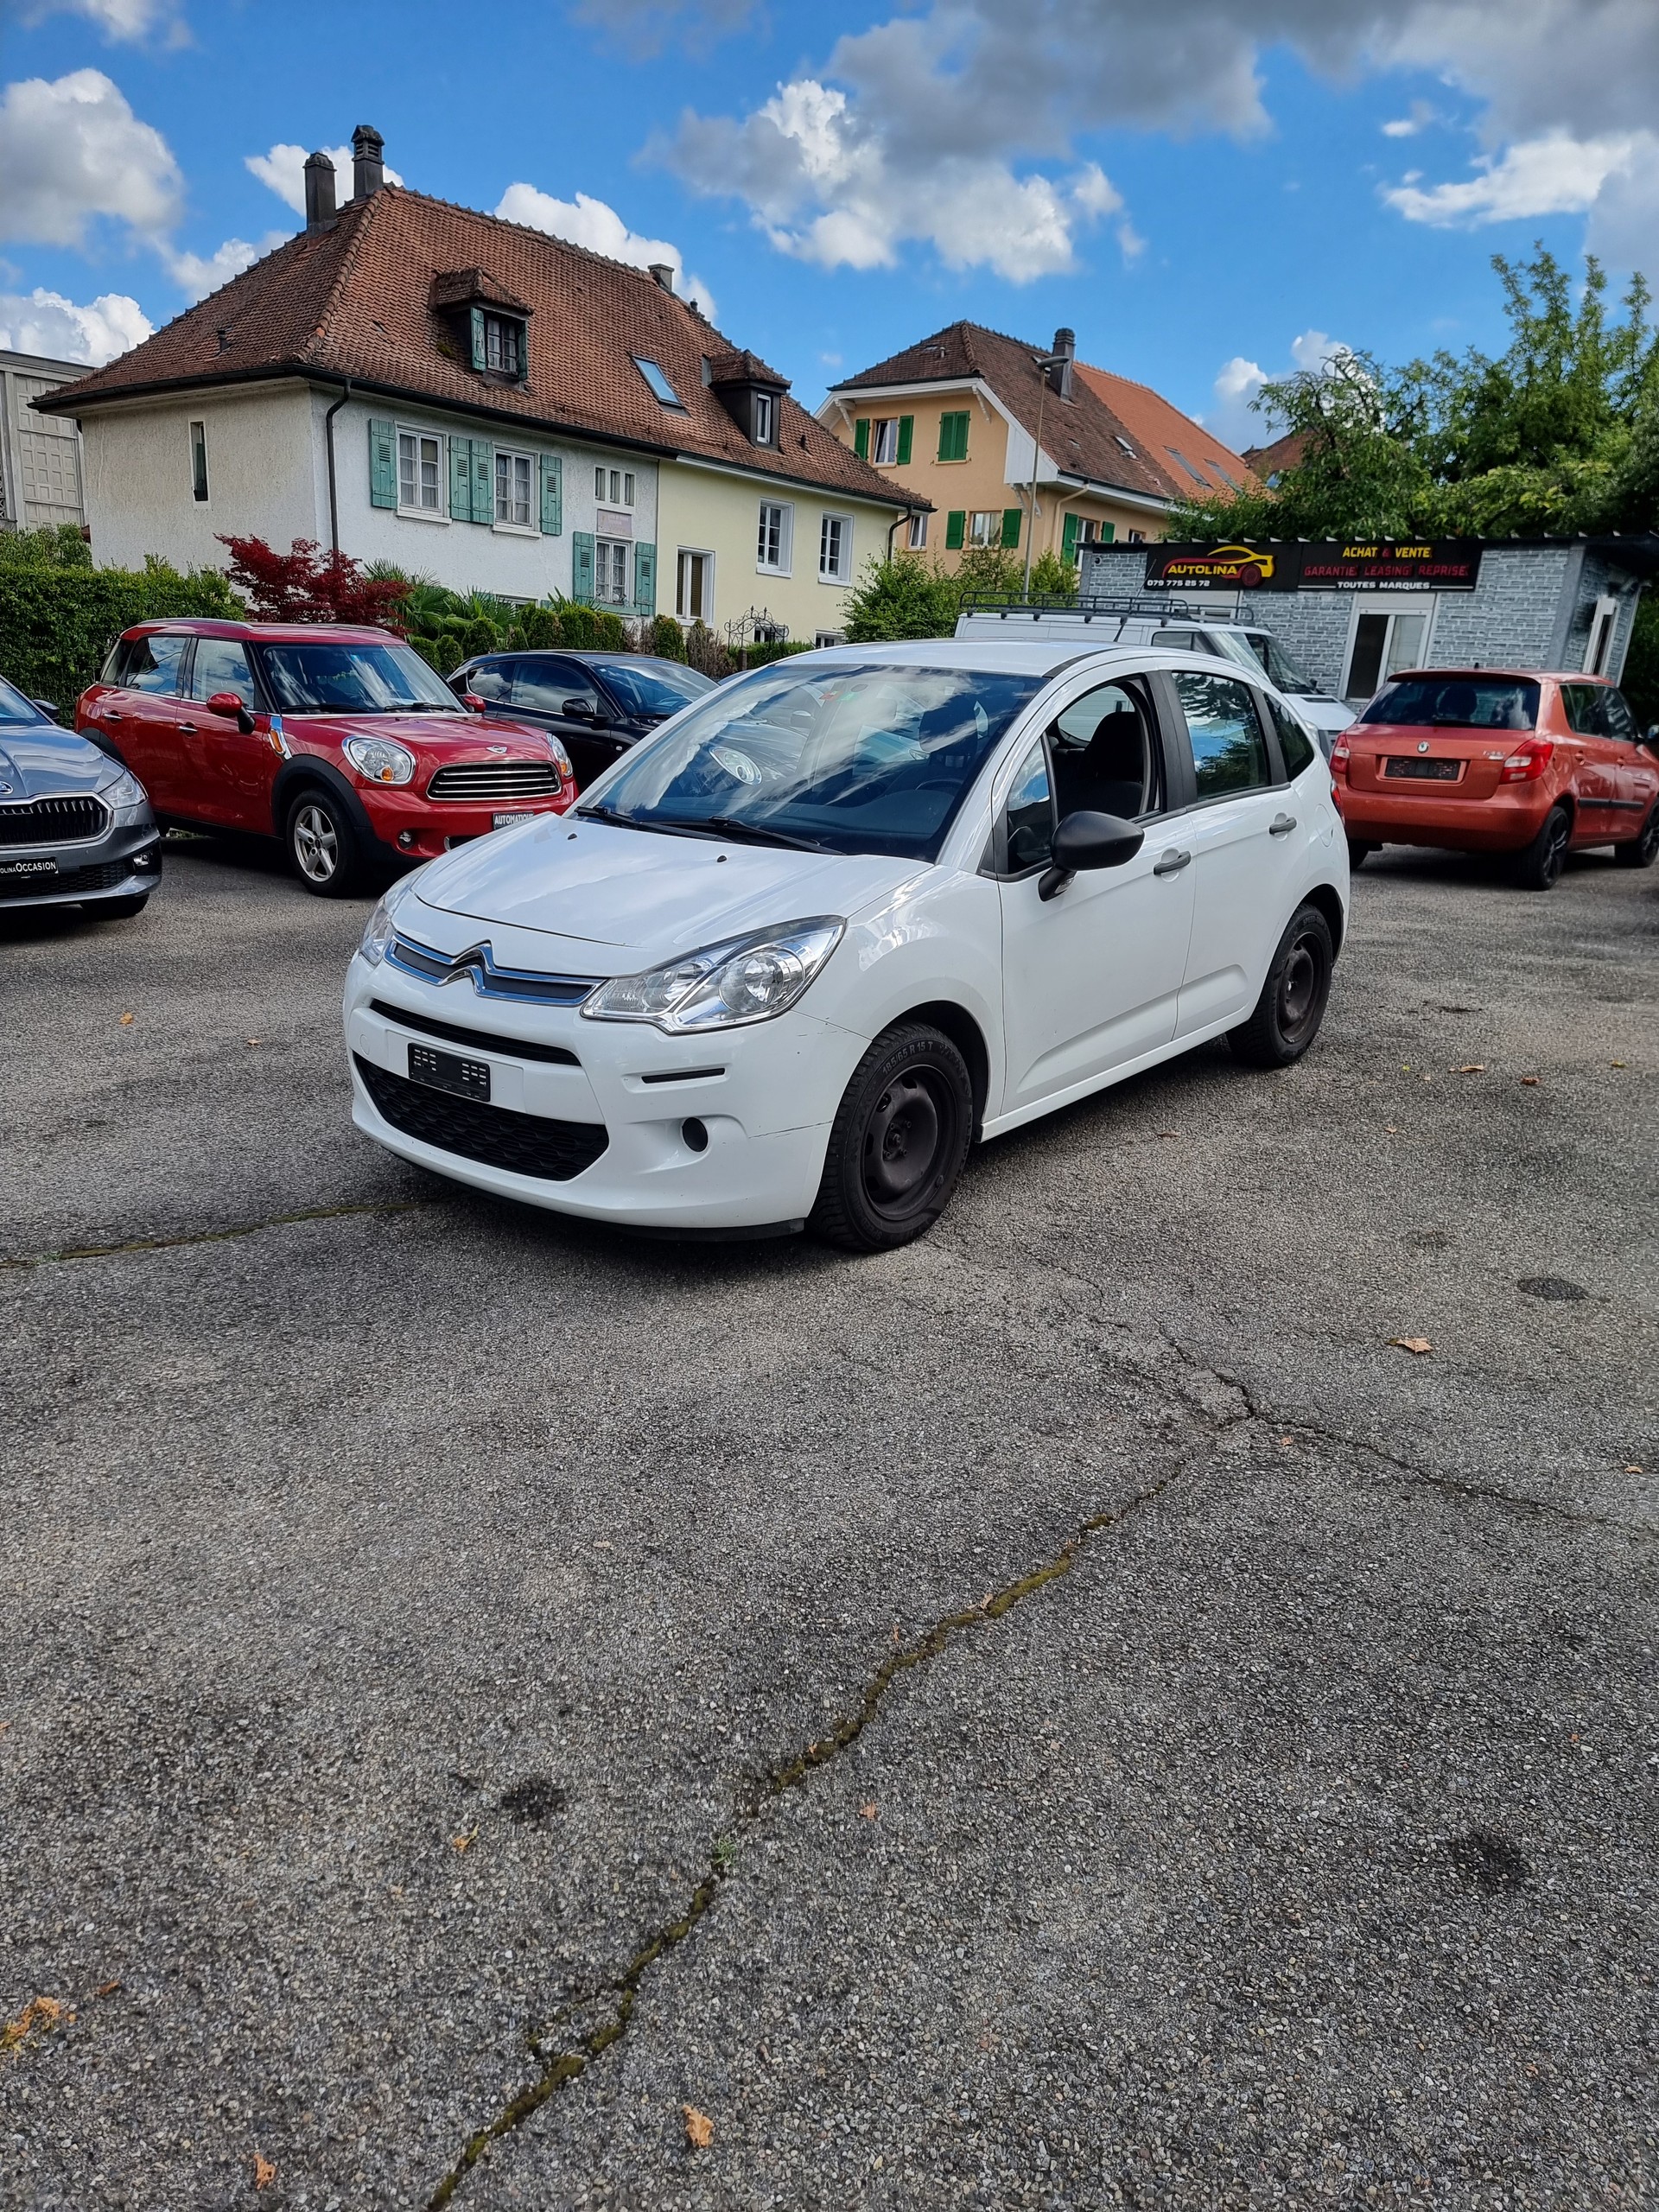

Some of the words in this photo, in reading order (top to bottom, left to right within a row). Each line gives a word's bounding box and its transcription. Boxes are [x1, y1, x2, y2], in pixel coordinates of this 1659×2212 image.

[1343, 547, 1377, 558] ACHAT
[1395, 547, 1432, 558] VENTE
[1167, 564, 1238, 575] AUTOLINA
[1304, 565, 1357, 576] GARANTIE
[1364, 565, 1411, 576] LEASING
[1418, 565, 1468, 576] REPRISE
[1338, 581, 1376, 589] TOUTES
[1379, 582, 1431, 590] MARQUES
[909, 1044, 916, 1055] R
[917, 1041, 925, 1052] 15
[927, 1041, 934, 1052] T
